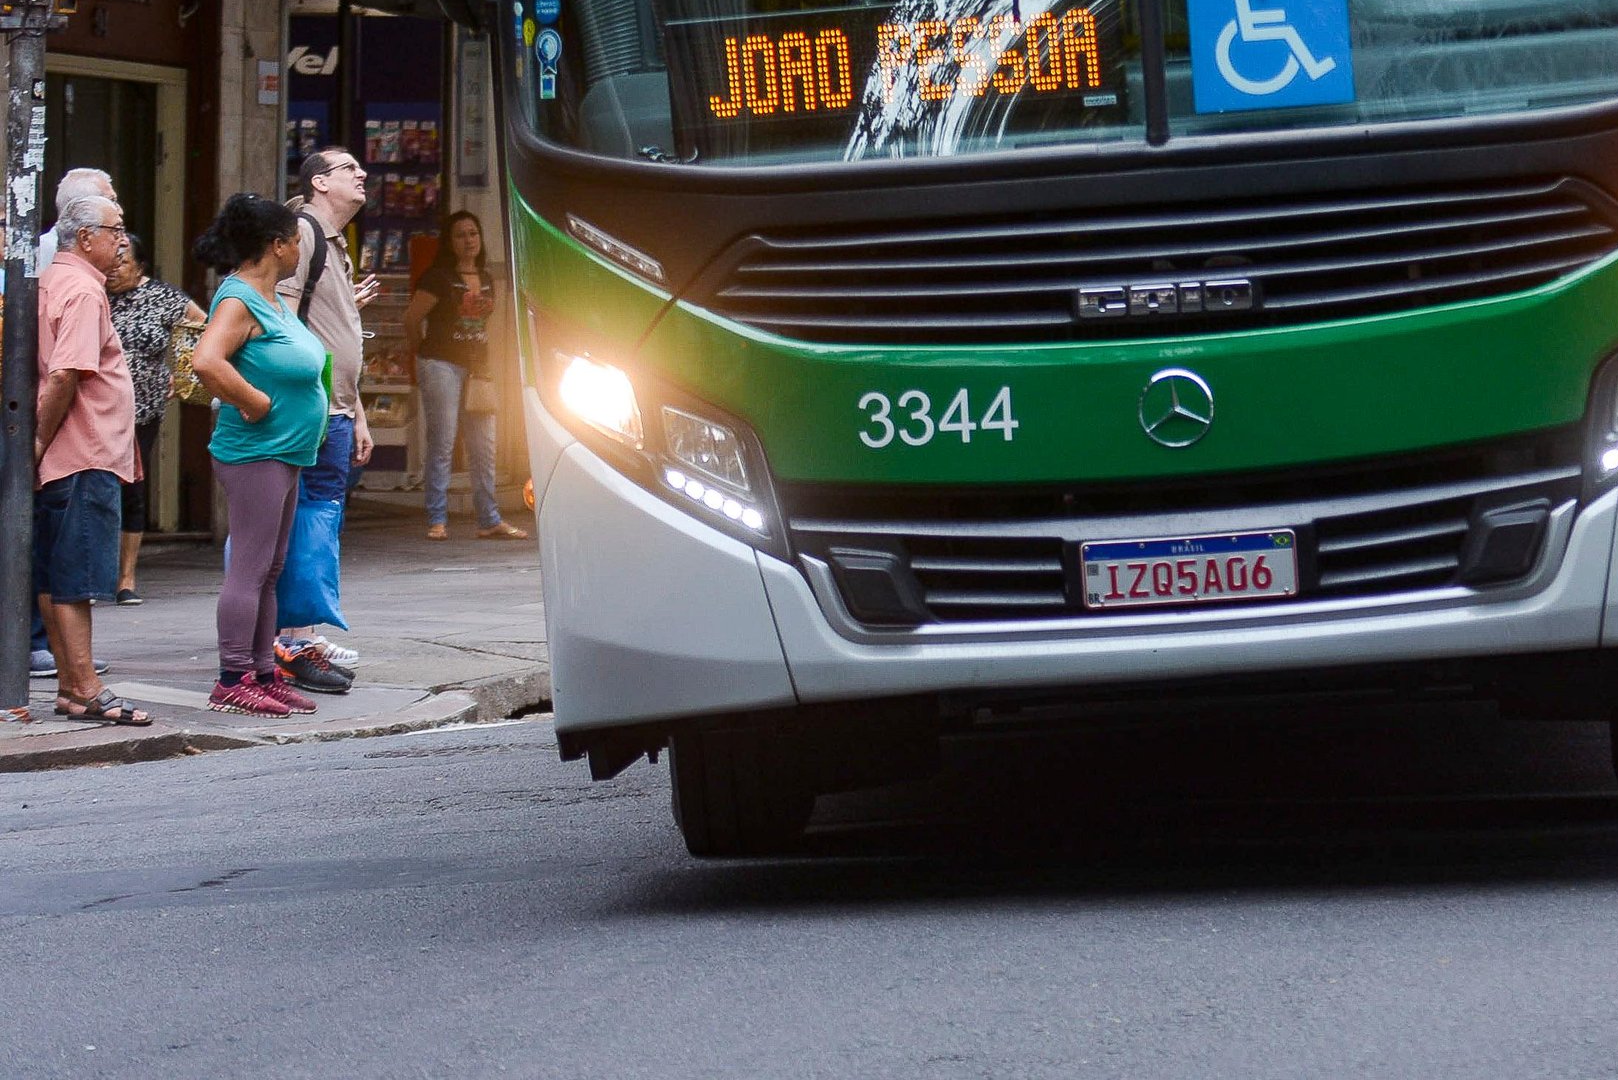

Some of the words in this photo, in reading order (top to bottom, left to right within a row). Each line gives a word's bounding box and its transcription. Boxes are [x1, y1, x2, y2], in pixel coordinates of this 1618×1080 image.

[709, 28, 852, 117] JOAO
[875, 7, 1101, 104] PESSOA
[857, 386, 1019, 449] 3344
[1105, 555, 1273, 601] IZQ5A06
